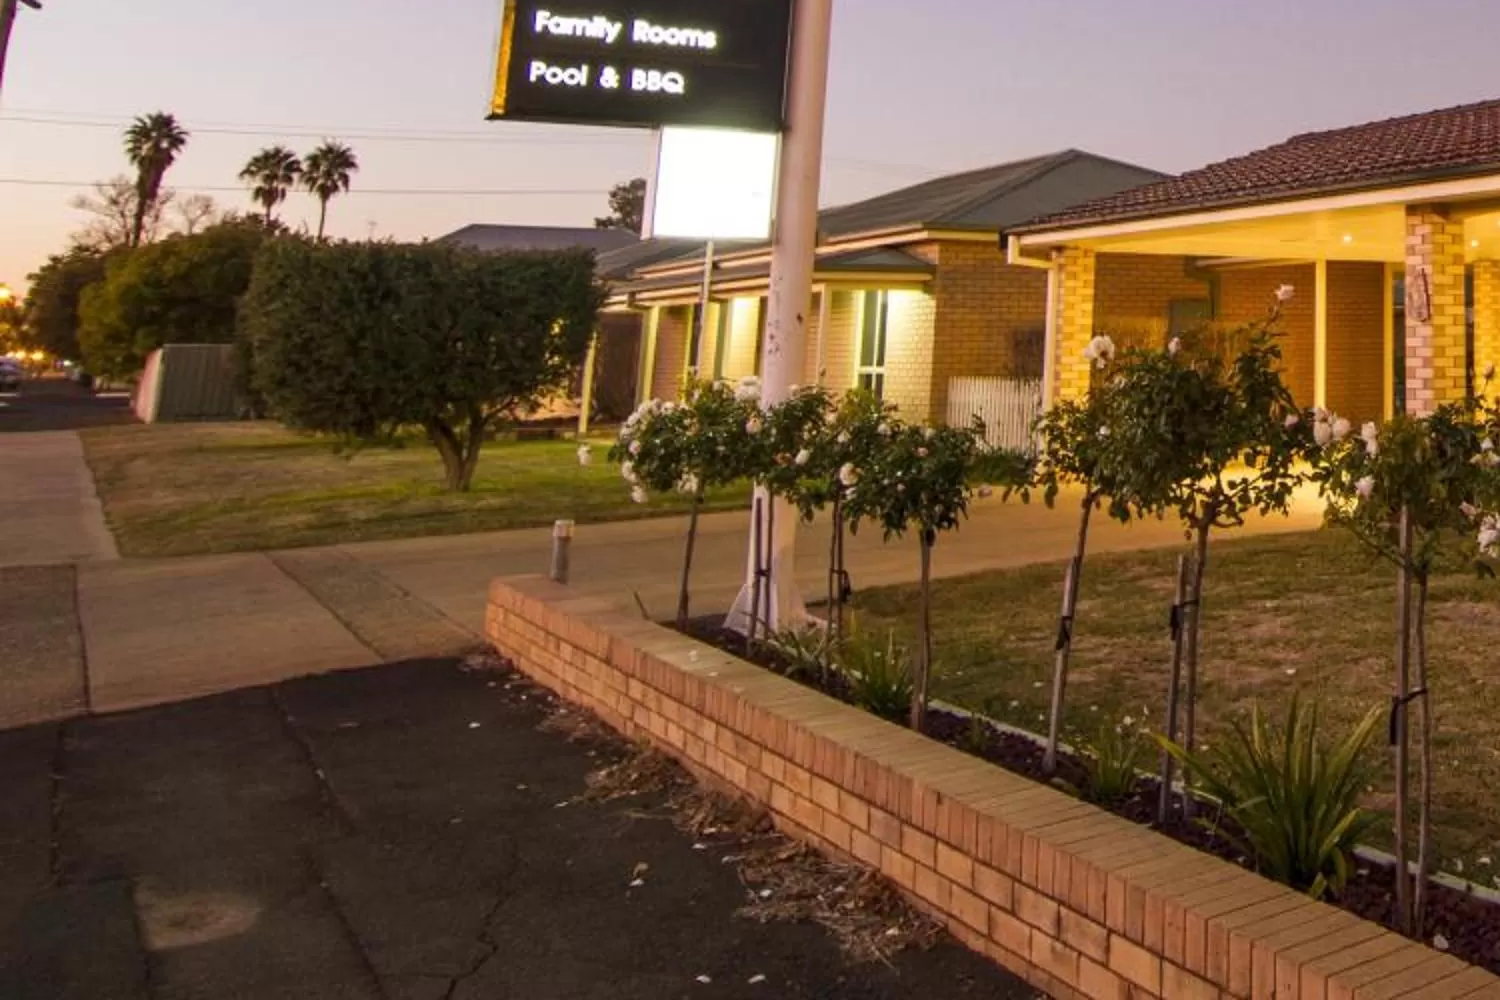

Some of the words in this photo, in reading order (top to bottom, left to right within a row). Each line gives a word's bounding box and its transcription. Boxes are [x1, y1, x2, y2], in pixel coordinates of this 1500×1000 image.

[535, 11, 621, 43] Family
[634, 21, 717, 49] Rooms
[529, 61, 588, 87] Pool
[600, 69, 619, 89] &
[631, 71, 685, 94] BBQ
